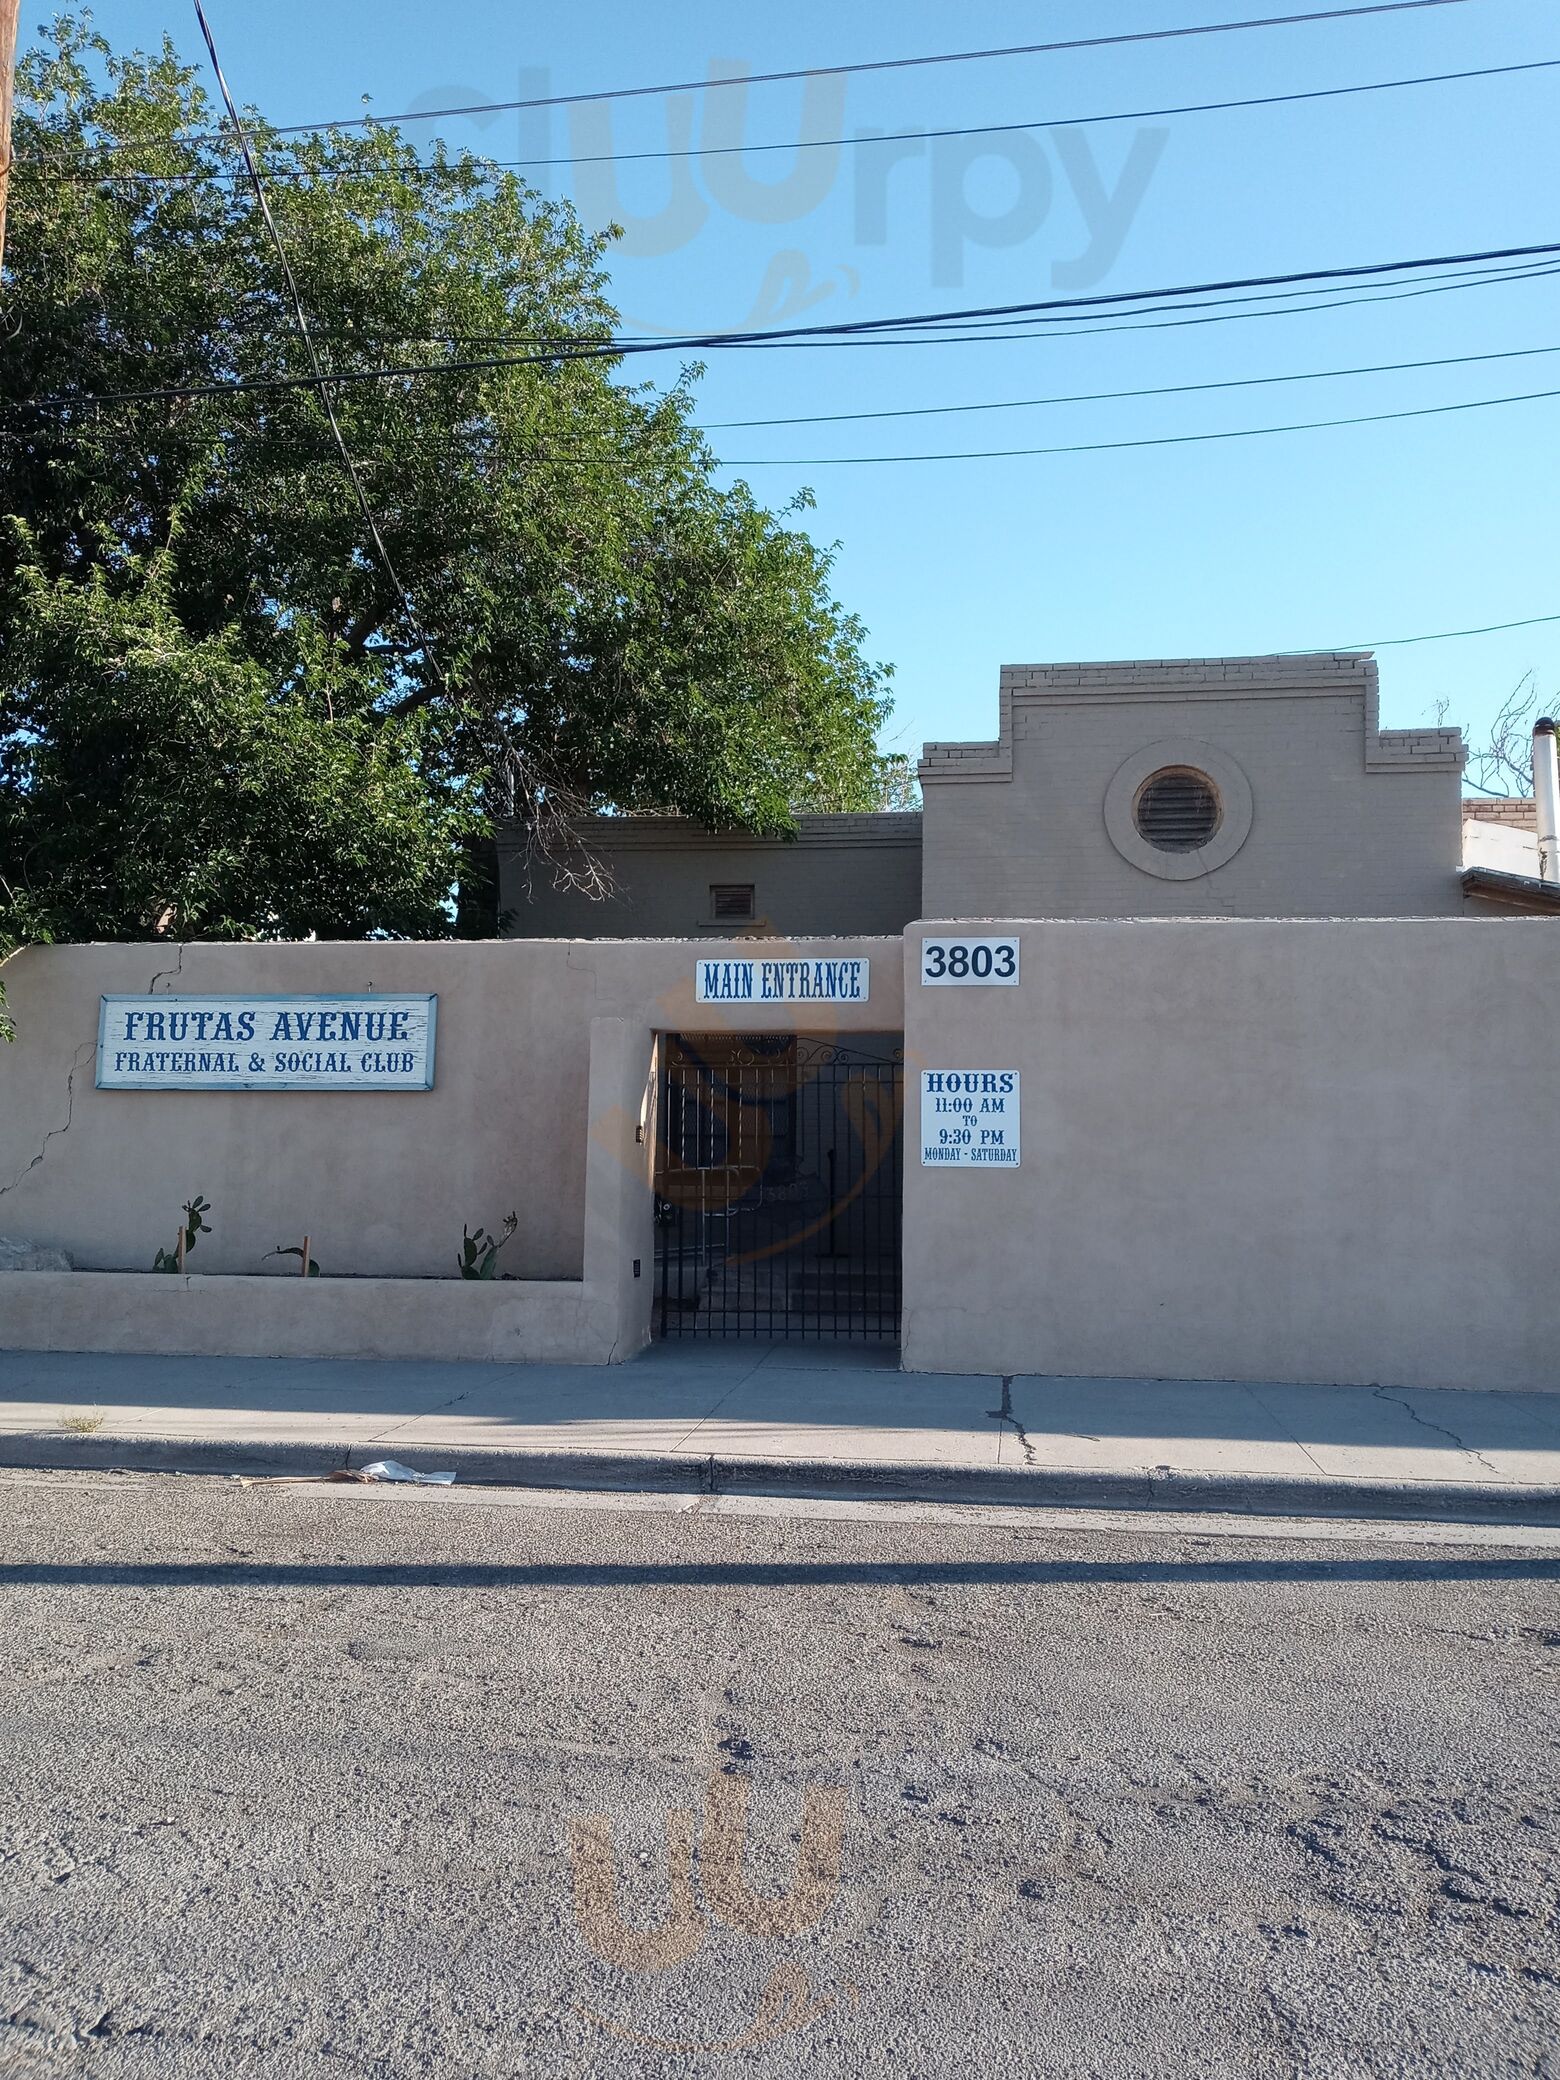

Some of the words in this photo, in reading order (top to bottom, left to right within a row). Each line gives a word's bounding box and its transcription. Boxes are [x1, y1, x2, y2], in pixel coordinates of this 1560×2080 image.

[925, 945, 1016, 978] 3803
[703, 962, 754, 999] MAIN
[760, 961, 861, 999] ENTRANCE
[123, 1011, 258, 1042] FRUTAS
[269, 1011, 409, 1042] AVENUE
[114, 1052, 240, 1073] FRATERNAL
[248, 1053, 266, 1073] &
[274, 1052, 351, 1073] SOCIAL
[360, 1052, 415, 1073] CLUB
[926, 1073, 1014, 1093] HOURS
[935, 1097, 973, 1113] 11:00
[979, 1098, 1005, 1113] AM
[962, 1115, 978, 1127] TO
[939, 1128, 971, 1145] 9:30
[980, 1129, 1005, 1145] PM
[925, 1147, 961, 1161] MONDAY
[971, 1148, 1017, 1162] SATURDAY
